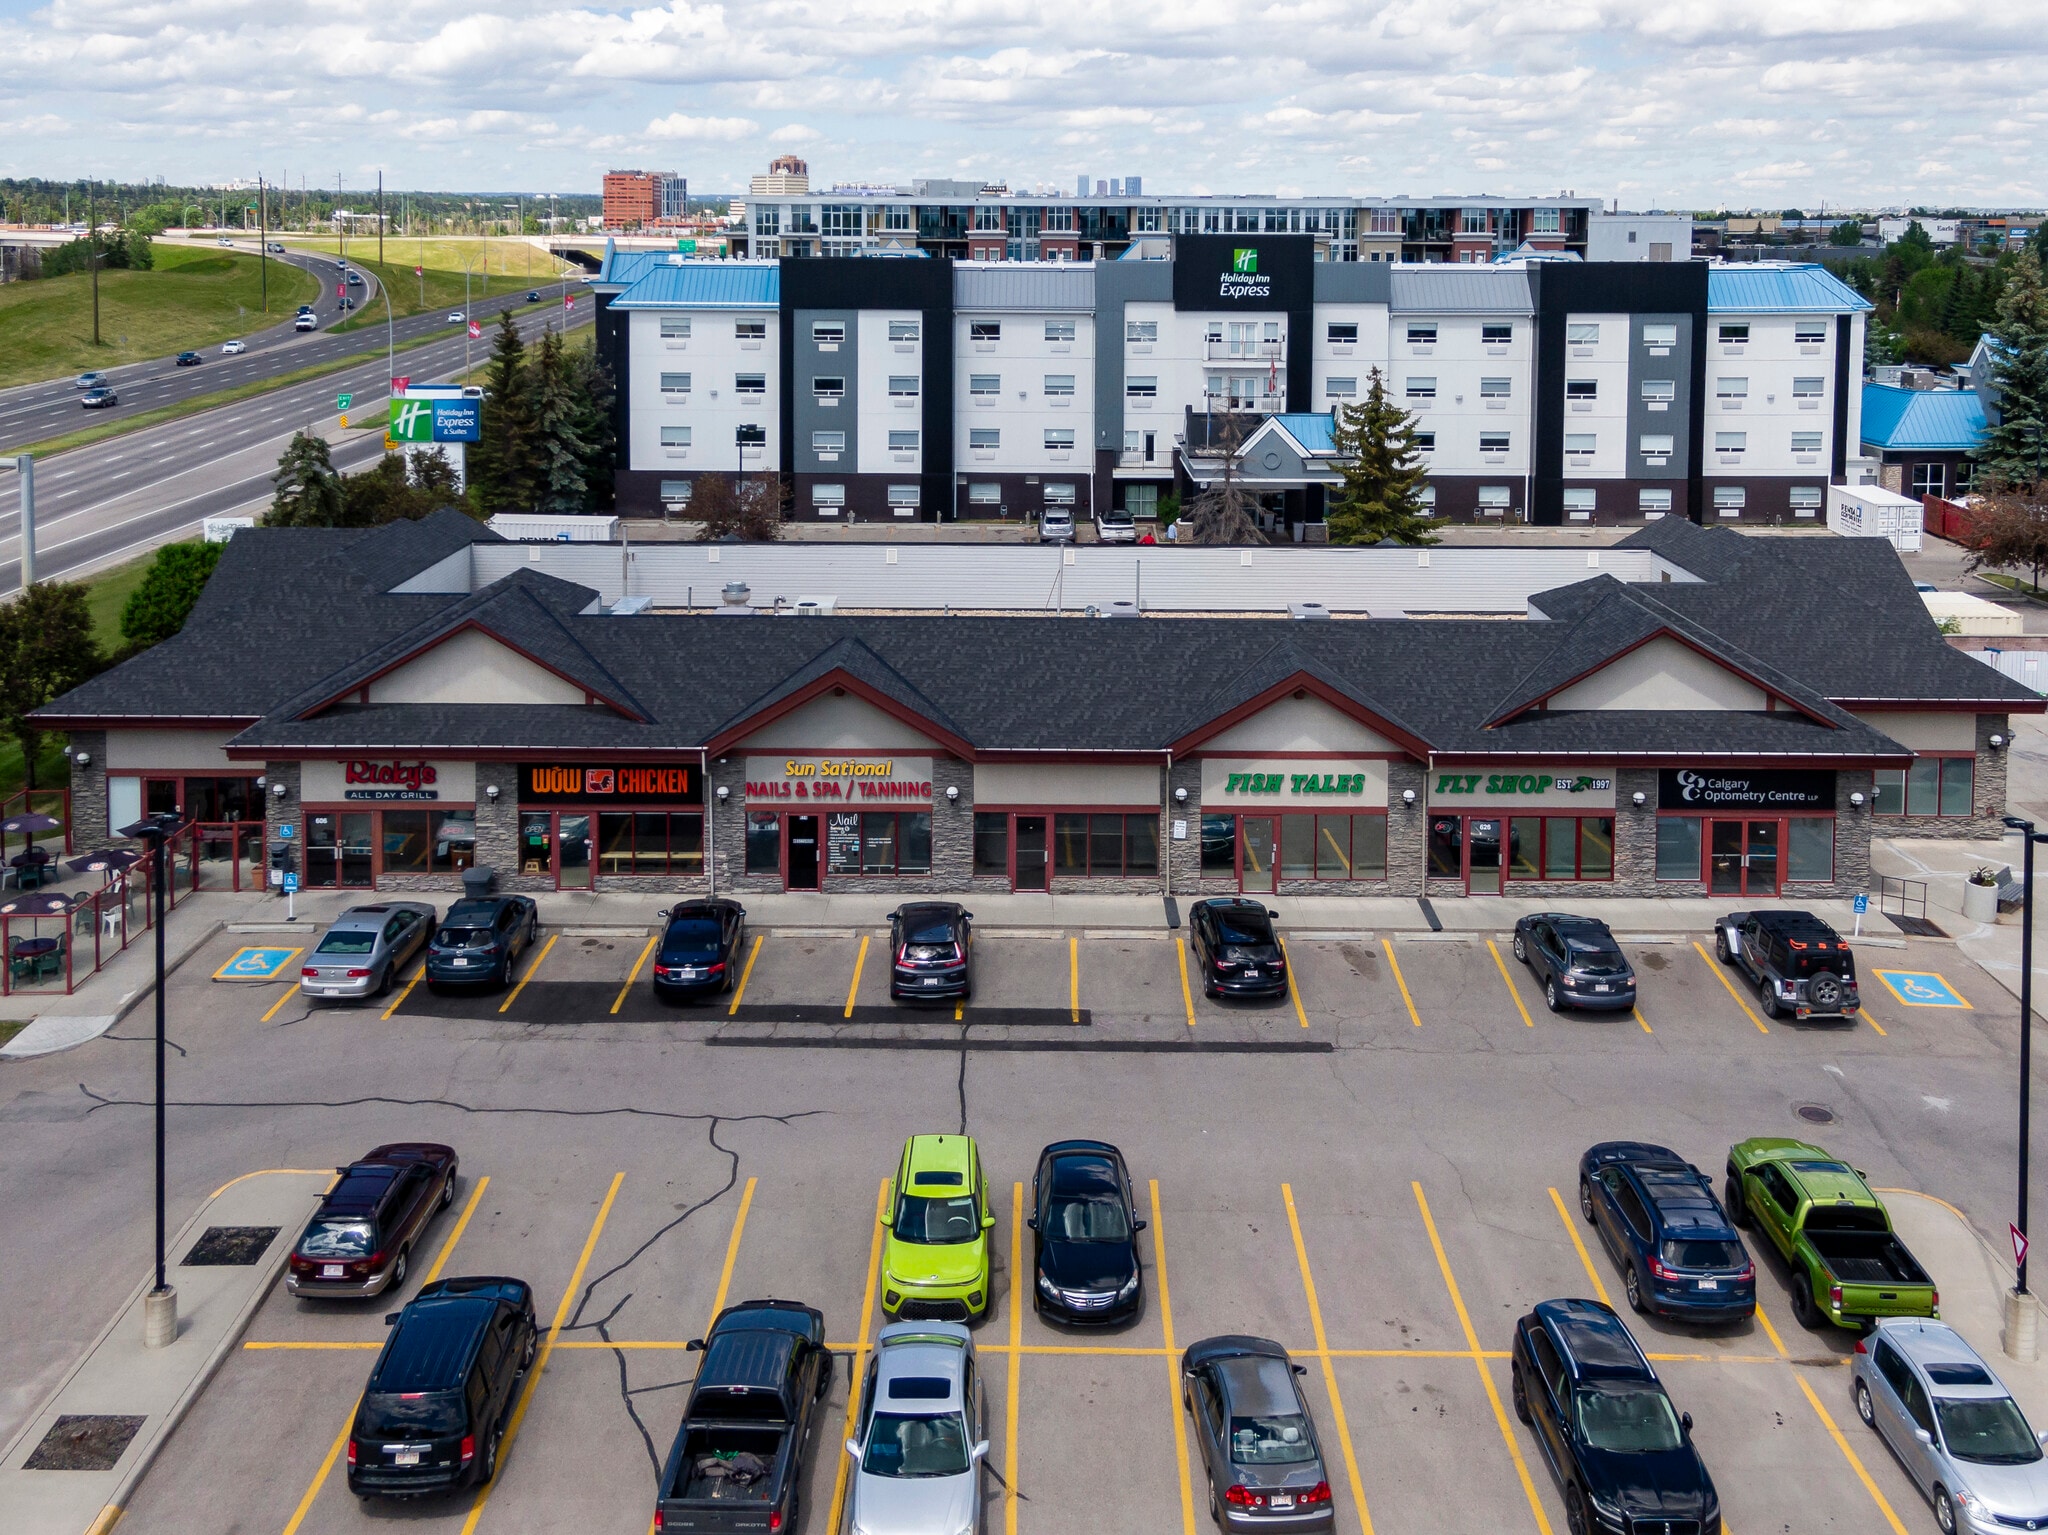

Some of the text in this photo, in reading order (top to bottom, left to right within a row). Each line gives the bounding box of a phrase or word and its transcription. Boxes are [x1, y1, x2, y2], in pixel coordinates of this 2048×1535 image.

[1220, 272, 1270, 285] Holiday Inn
[1220, 283, 1270, 299] Express
[437, 408, 475, 418] Holiday Inn
[437, 417, 475, 428] Express
[785, 759, 893, 777] Sun Sational
[338, 760, 436, 790] Ricky's
[618, 769, 688, 793] CHICKEN
[745, 781, 791, 797] NAILS
[795, 781, 808, 797] &
[813, 781, 843, 797] SPA
[857, 781, 932, 798] TANNING
[1225, 773, 1366, 793] FISH TALES
[1435, 775, 1610, 794] FLY SHOP EST 1997
[1707, 778, 1750, 791] Calgary
[350, 791, 432, 799] ALL DAY GRILL
[1704, 790, 1766, 803] Optometry
[1768, 790, 1805, 801] Centre
[829, 813, 858, 826] Nail
[525, 825, 544, 833] OPEN
